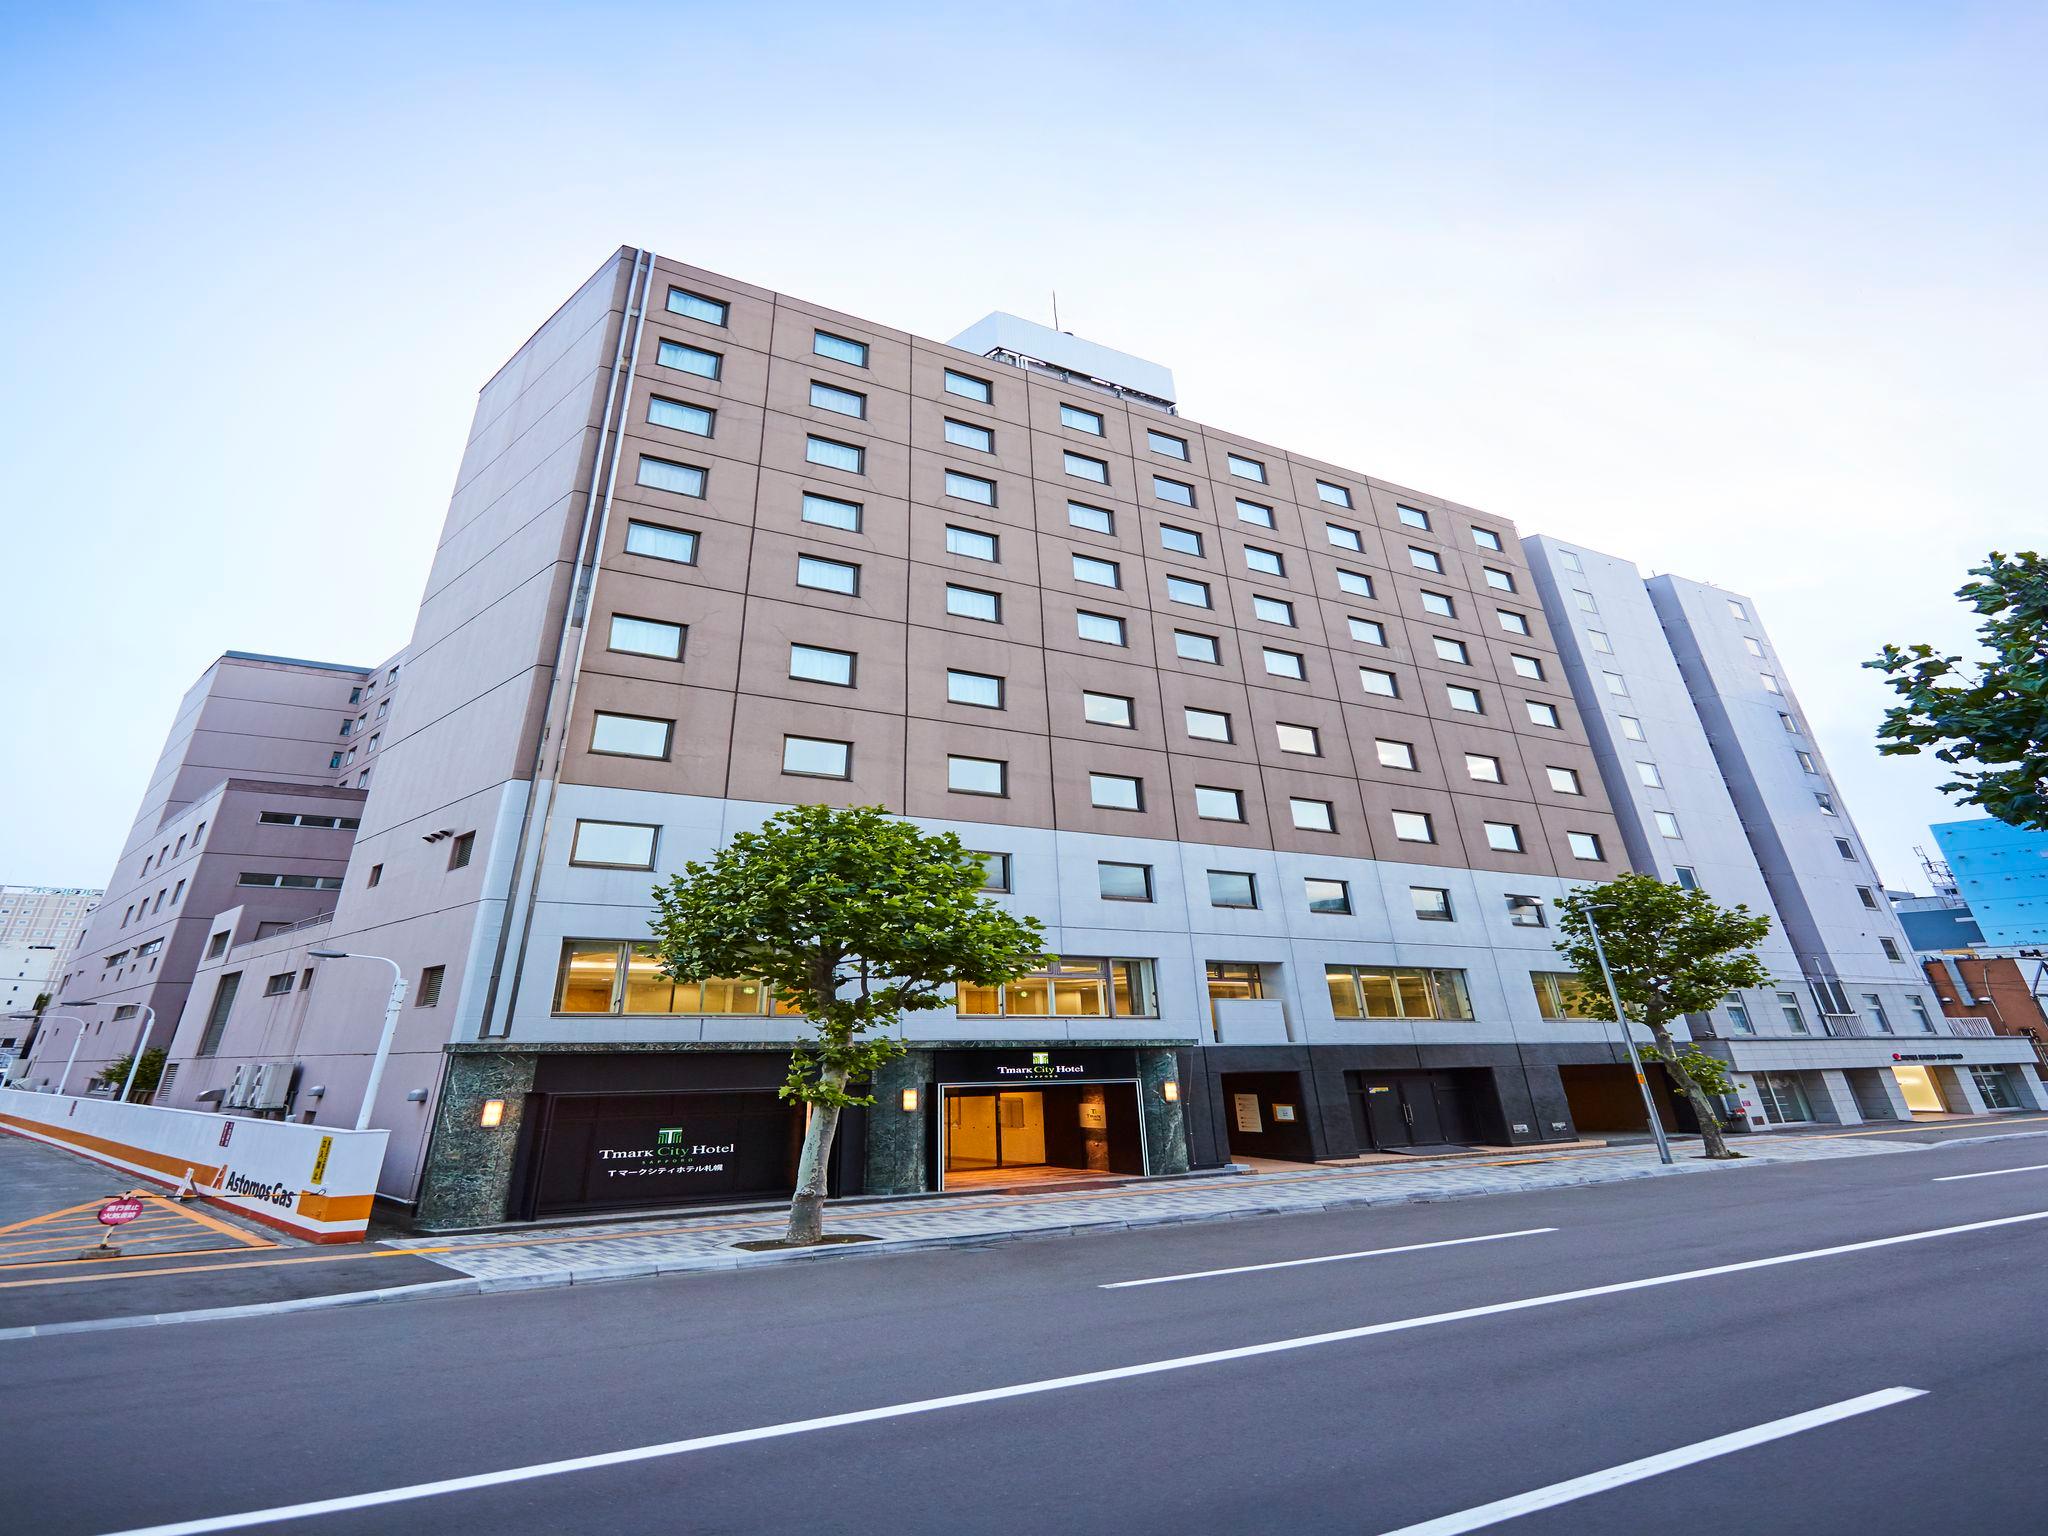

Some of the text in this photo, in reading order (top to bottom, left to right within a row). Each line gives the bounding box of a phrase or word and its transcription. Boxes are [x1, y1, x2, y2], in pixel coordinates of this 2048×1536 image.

[997, 1065, 1084, 1075] Tmark City Hotel
[599, 1143, 735, 1160] Tmark City Hotel
[225, 1171, 295, 1208] Astomos Gas
